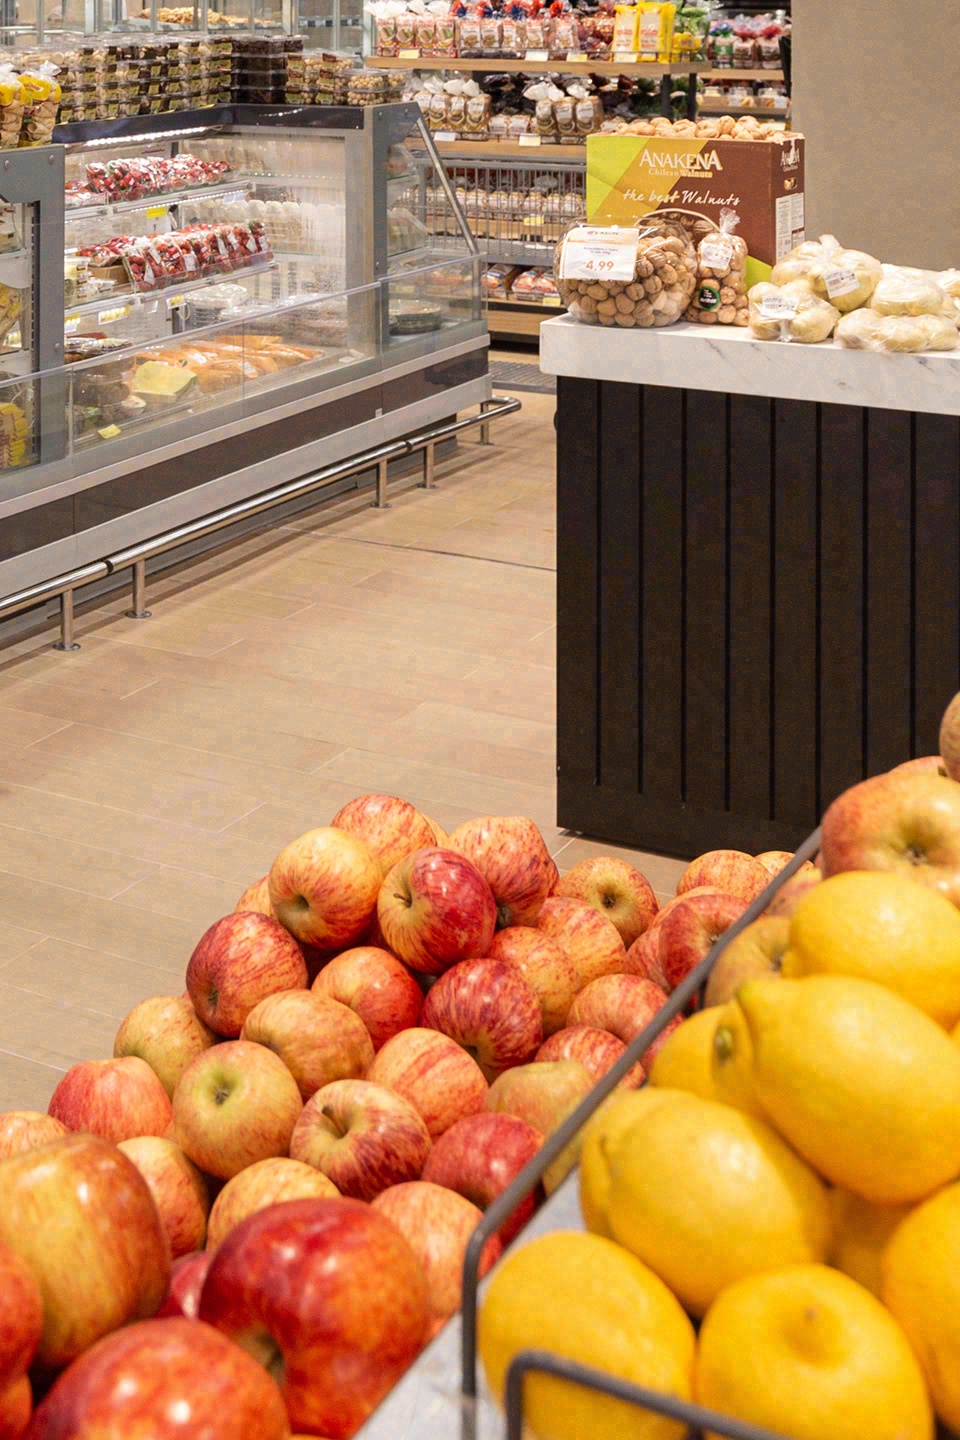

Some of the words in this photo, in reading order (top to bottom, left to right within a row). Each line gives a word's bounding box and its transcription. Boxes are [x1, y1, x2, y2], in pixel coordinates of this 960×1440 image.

[639, 148, 723, 171] ANAKENA
[648, 168, 678, 177] Chilean
[679, 169, 713, 178] Walnuts
[623, 189, 645, 202] the
[649, 190, 680, 203] best
[681, 190, 740, 206] Walnuts
[586, 260, 615, 272] 4,99
